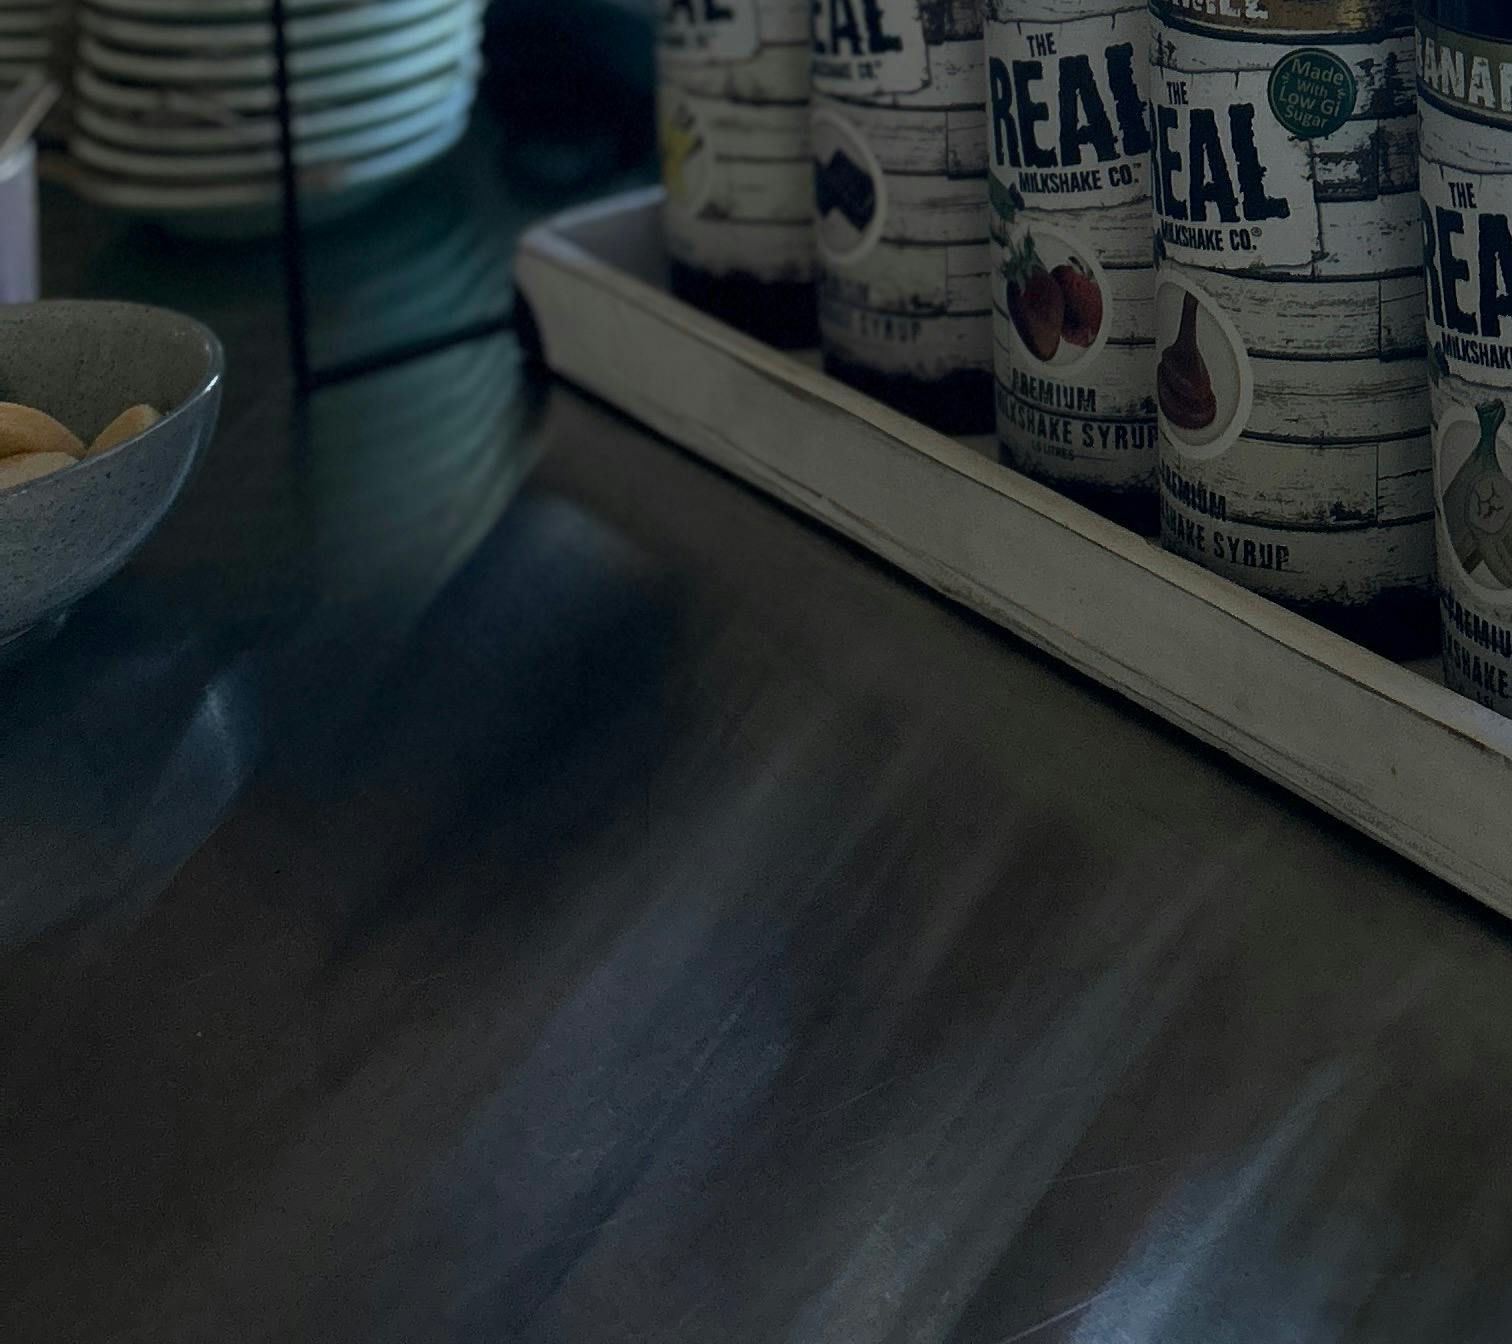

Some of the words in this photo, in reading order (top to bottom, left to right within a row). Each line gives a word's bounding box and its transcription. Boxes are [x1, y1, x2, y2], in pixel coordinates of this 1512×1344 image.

[1027, 33, 1057, 57] THE
[1291, 58, 1344, 86] Made
[1167, 81, 1189, 105] THE
[1279, 85, 1316, 110] Low
[1296, 79, 1328, 98] With
[989, 41, 1150, 168] REAL
[1284, 103, 1329, 129] Sugar
[1019, 171, 1103, 194] MILKSHAKE
[1448, 182, 1476, 209] THE
[1012, 367, 1097, 414] PREMIUM
[1213, 531, 1289, 572] SYRUP
